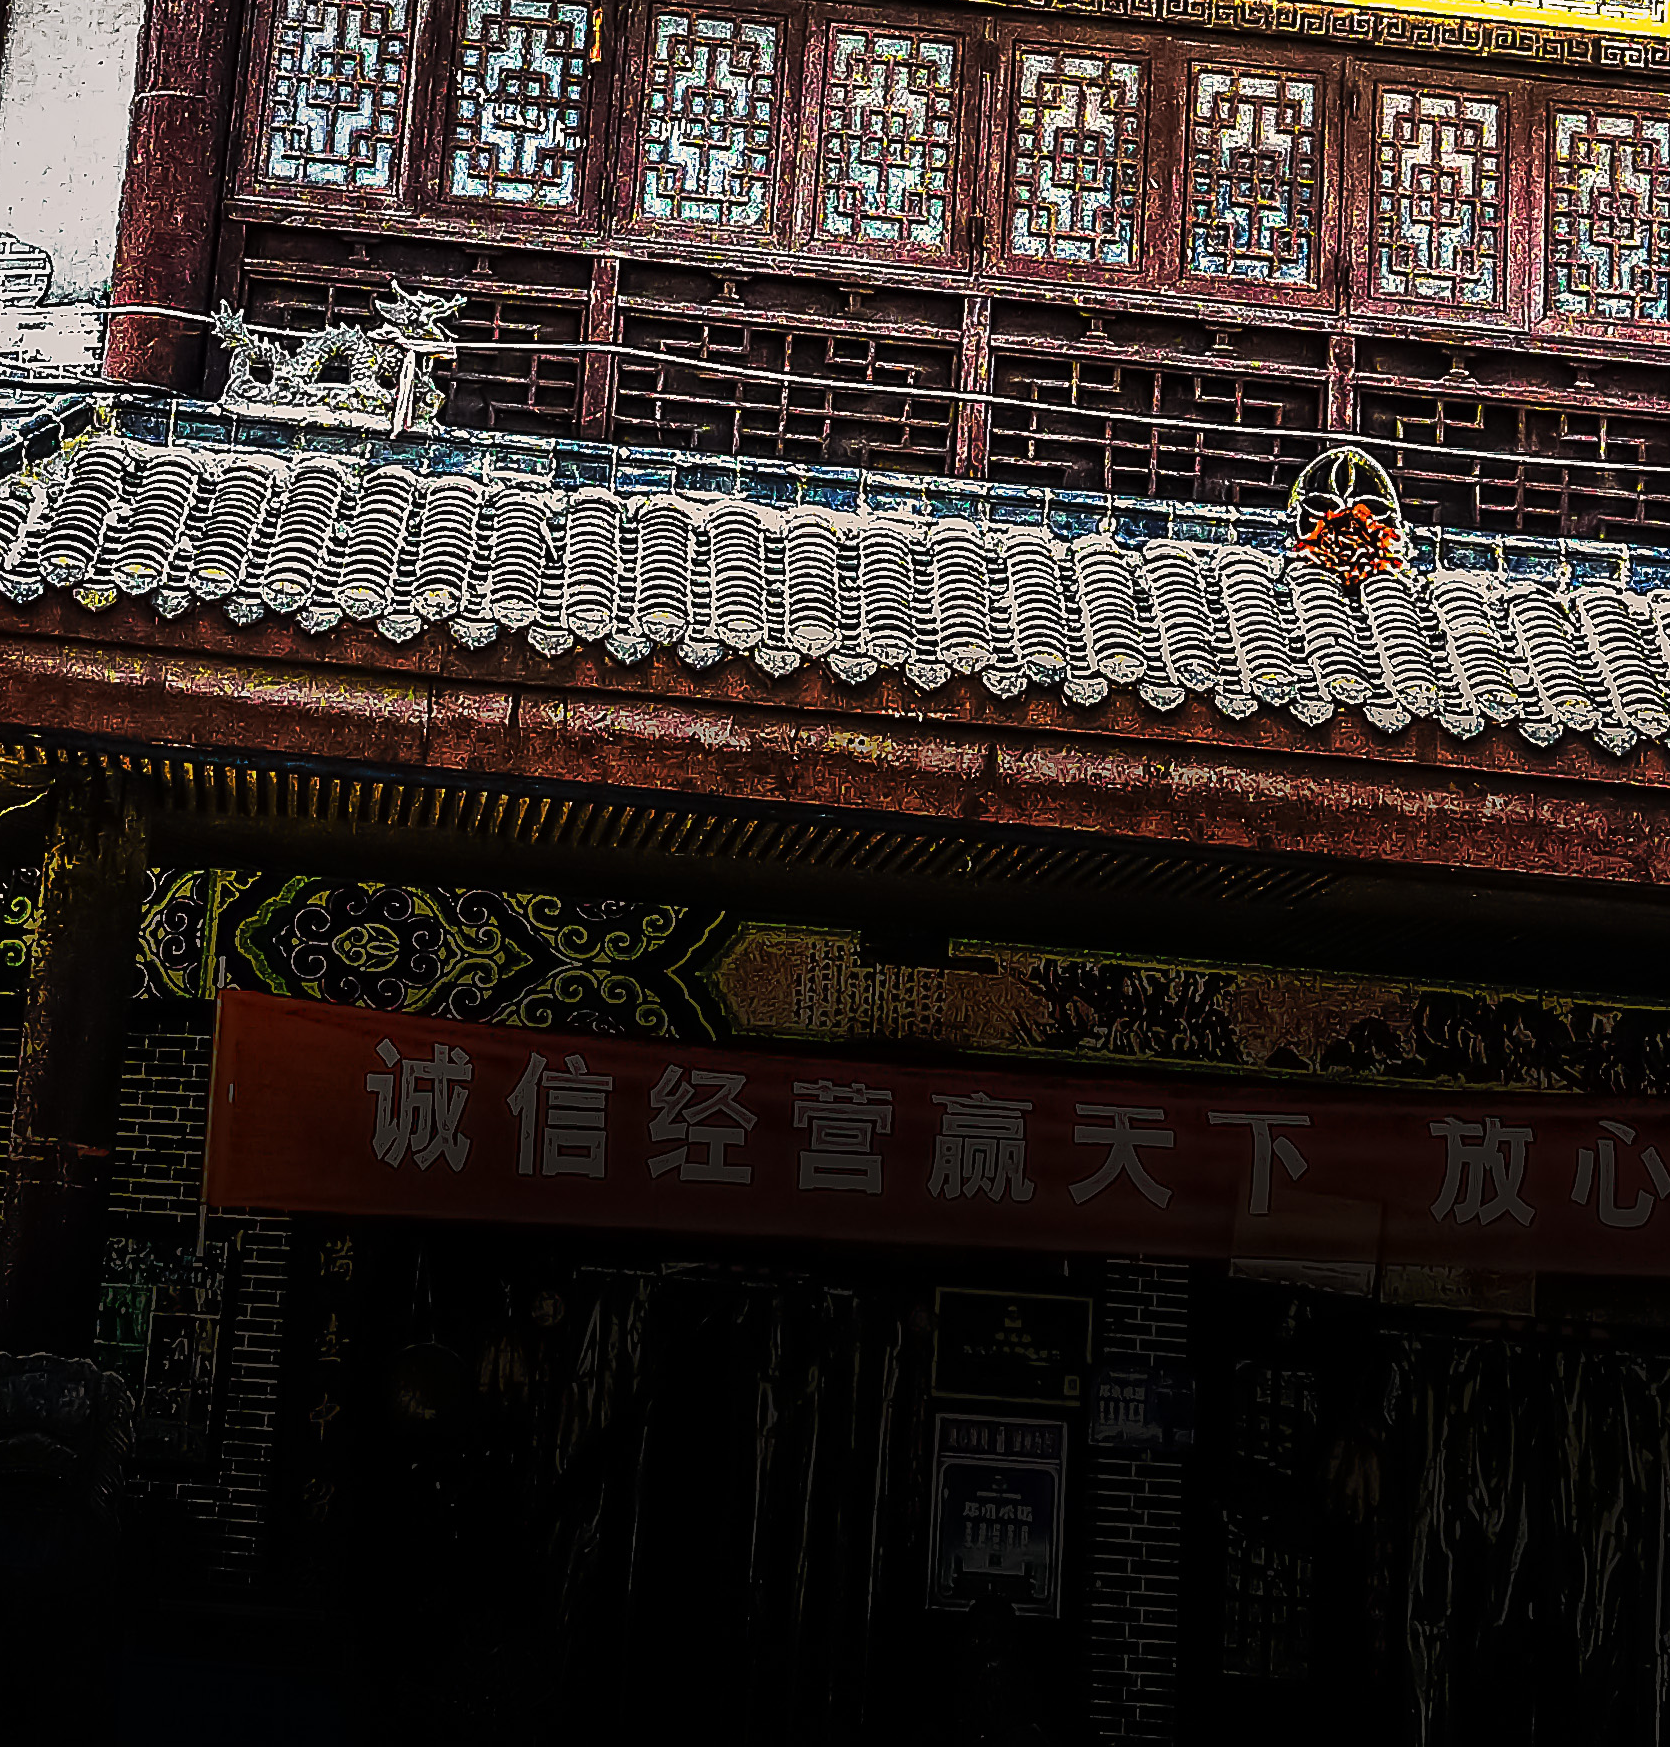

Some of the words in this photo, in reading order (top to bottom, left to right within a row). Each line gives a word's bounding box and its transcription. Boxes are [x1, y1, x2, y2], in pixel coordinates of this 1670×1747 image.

[365, 1038, 1317, 1216] 诚信经营赢天下
